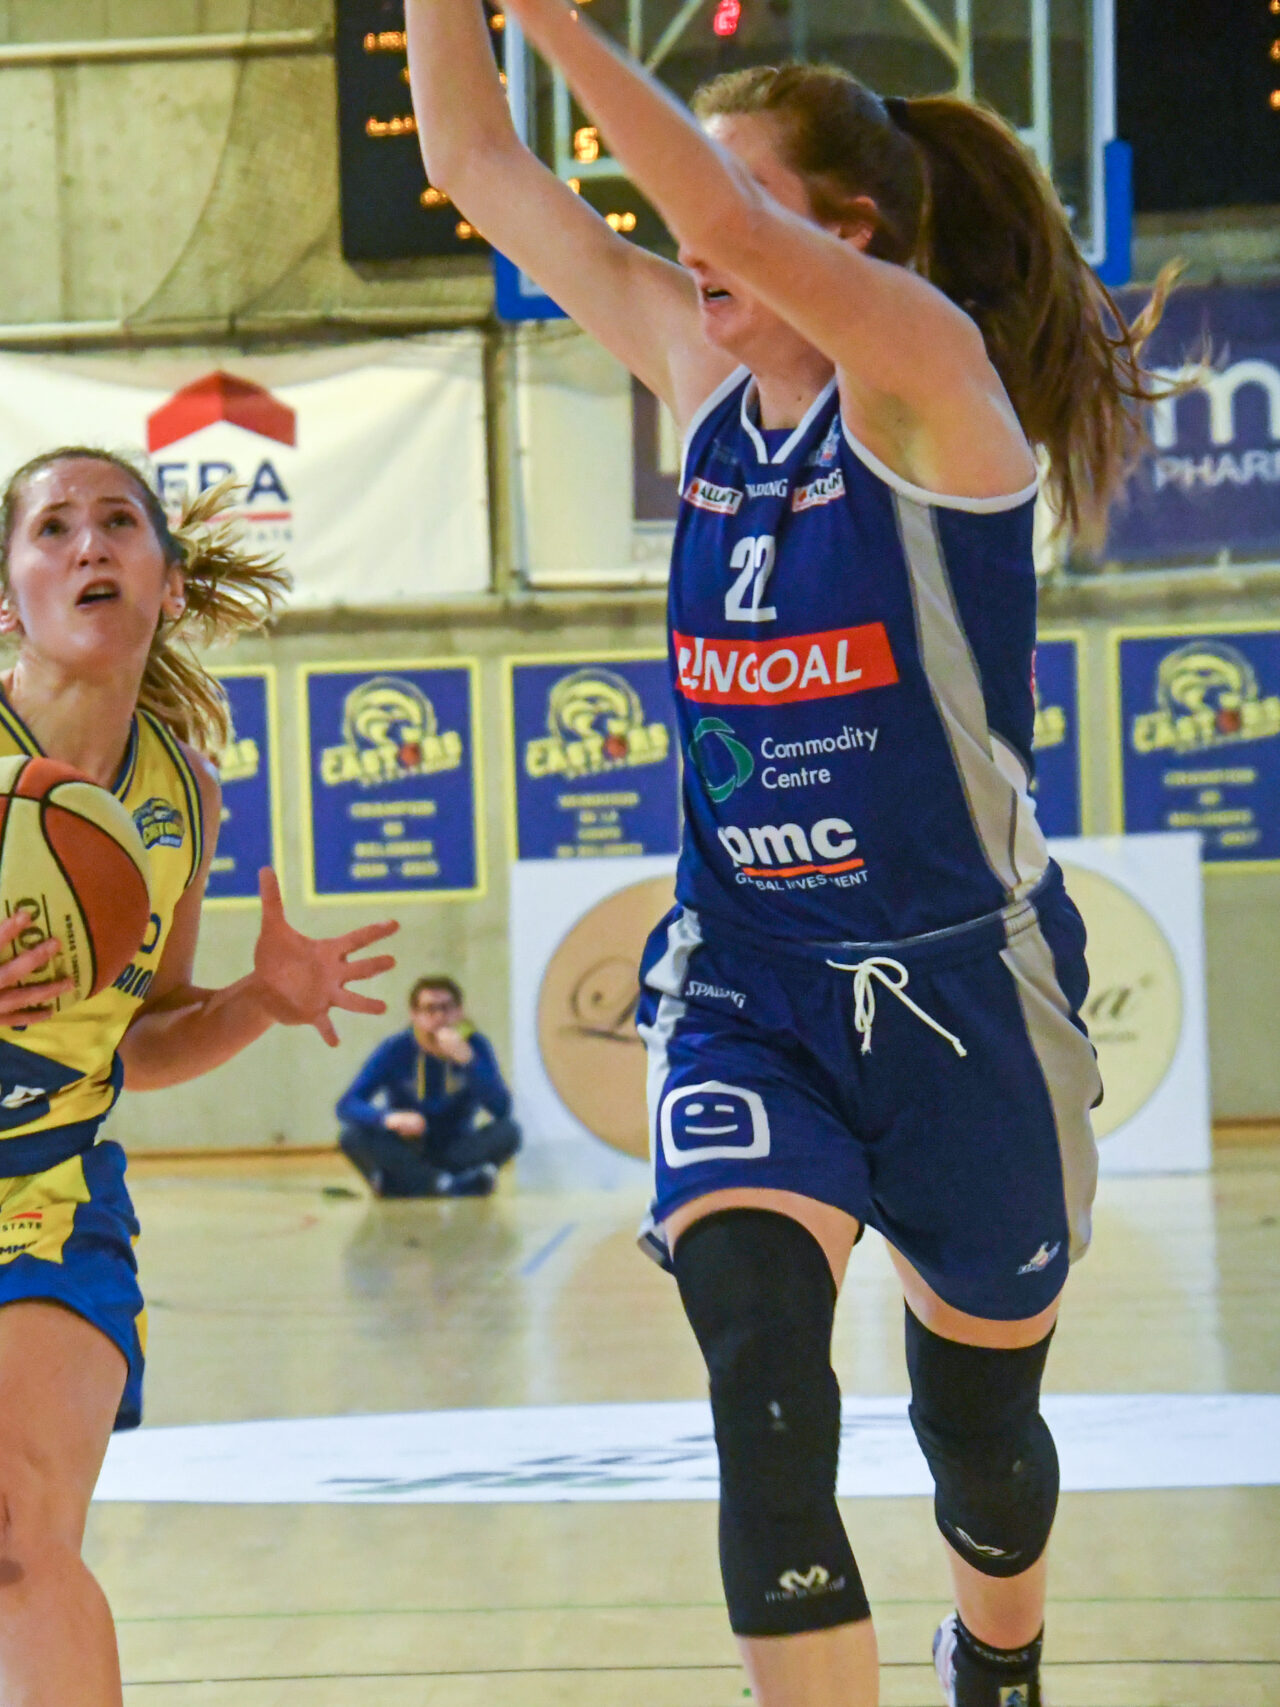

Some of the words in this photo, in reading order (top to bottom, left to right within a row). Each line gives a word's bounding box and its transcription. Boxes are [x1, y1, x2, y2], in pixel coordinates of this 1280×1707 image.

[724, 535, 778, 622] 22
[760, 725, 878, 760] Commodity
[761, 766, 831, 790] Centre
[717, 817, 857, 868] pmc
